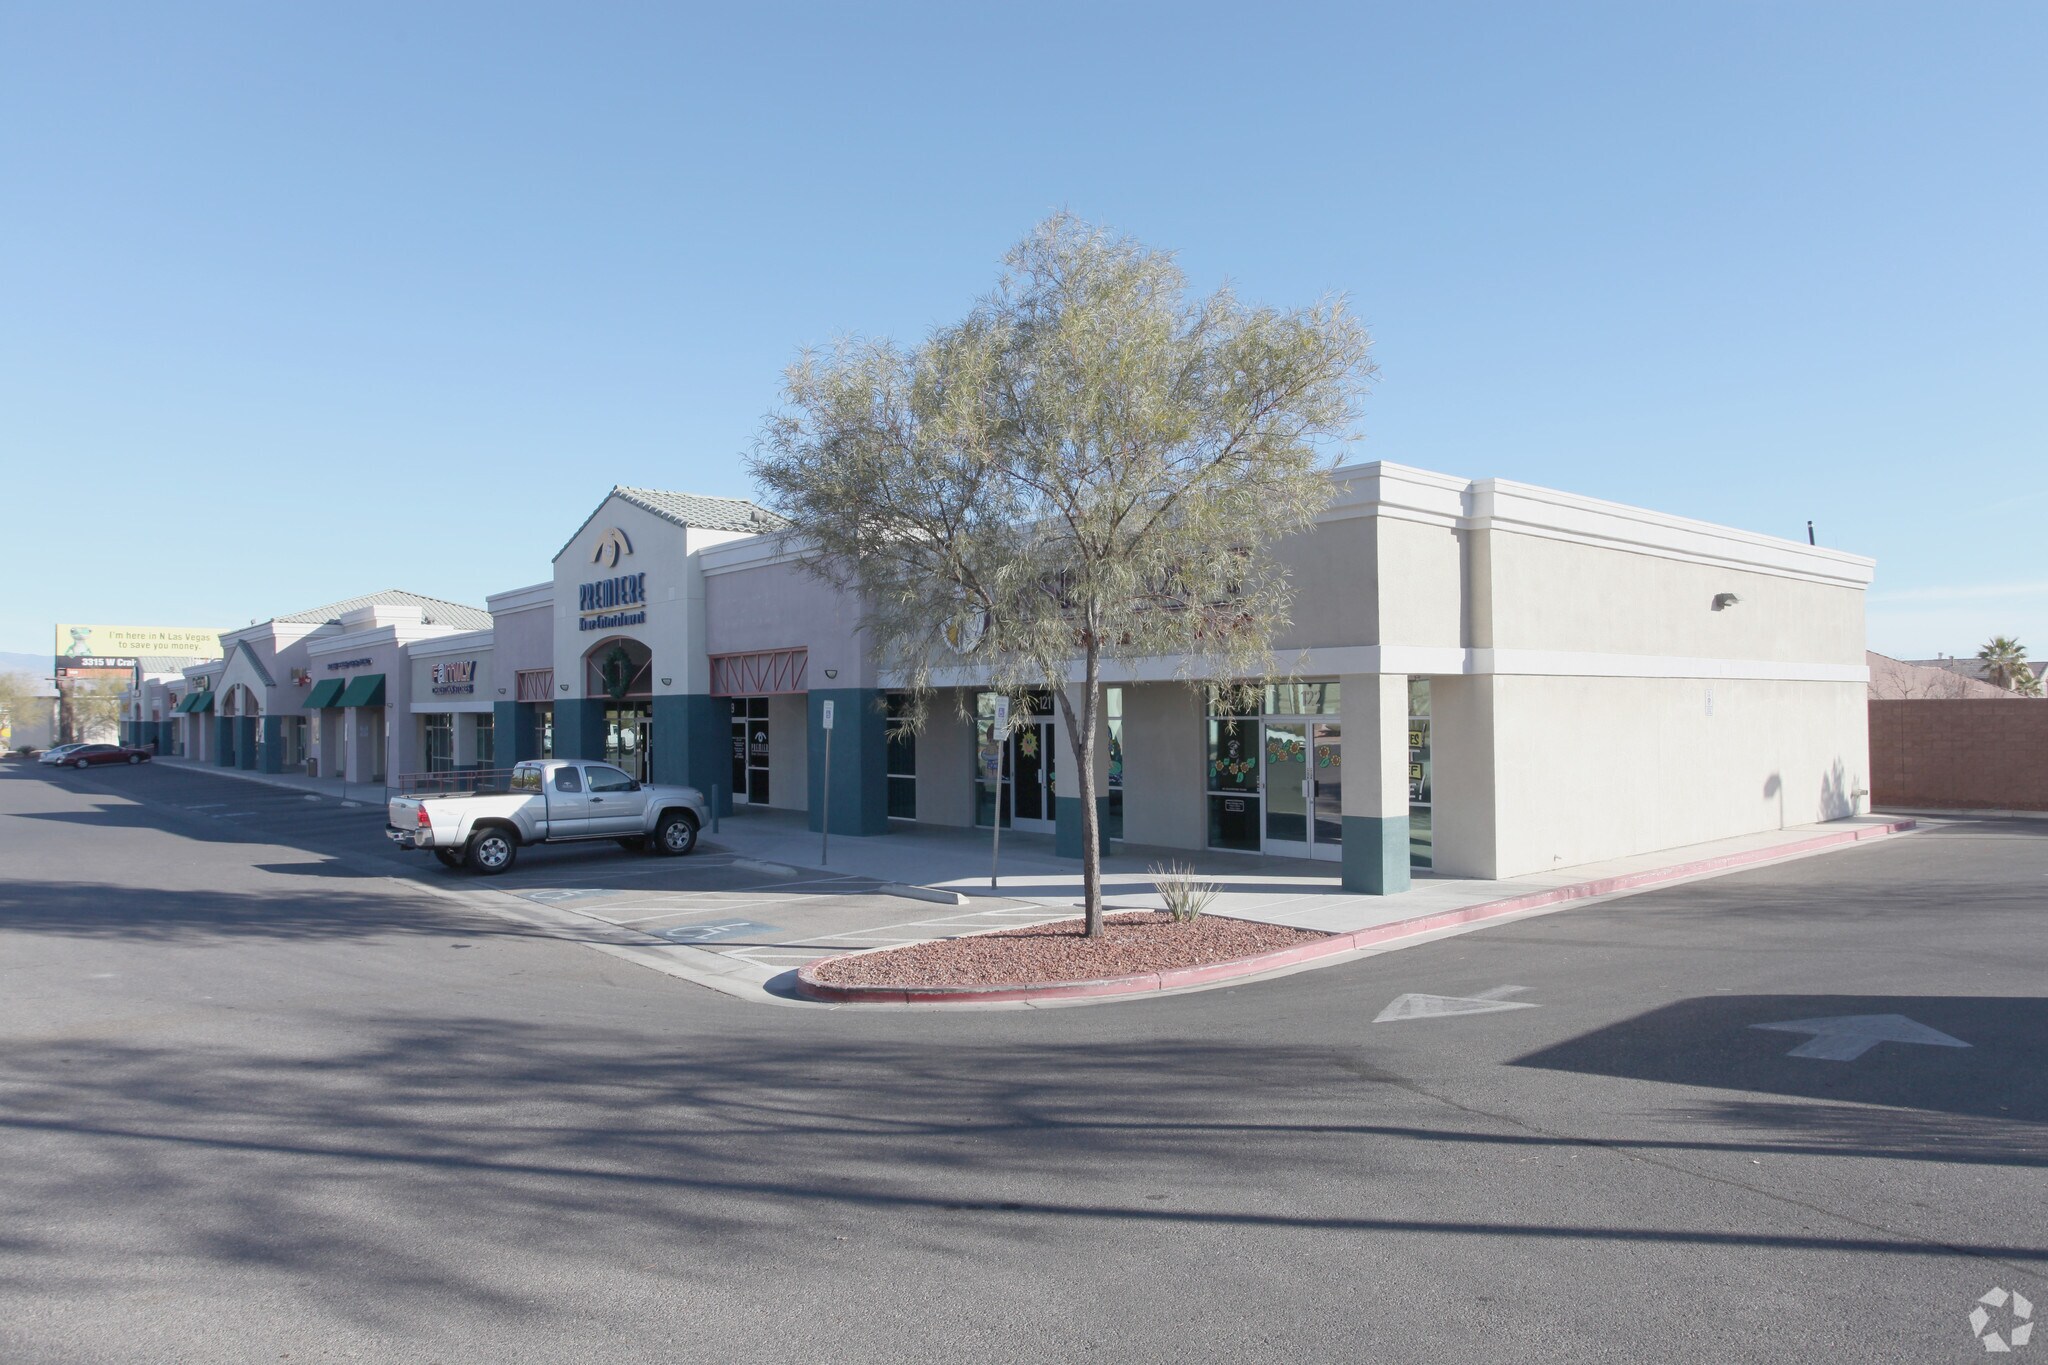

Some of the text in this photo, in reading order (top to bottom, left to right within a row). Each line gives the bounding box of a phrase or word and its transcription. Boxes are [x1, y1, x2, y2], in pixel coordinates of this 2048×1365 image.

[579, 572, 646, 611] PREMIERE
[109, 631, 123, 639] I'm
[126, 632, 145, 640] here
[160, 632, 165, 640] N
[168, 633, 183, 641] Las
[185, 633, 211, 642] Vegas
[118, 641, 127, 649] to
[153, 642, 169, 650] you
[171, 643, 201, 651] money.
[81, 658, 136, 667] 3315 W Crai
[1039, 696, 1051, 710] 121
[1301, 690, 1321, 706] 122
